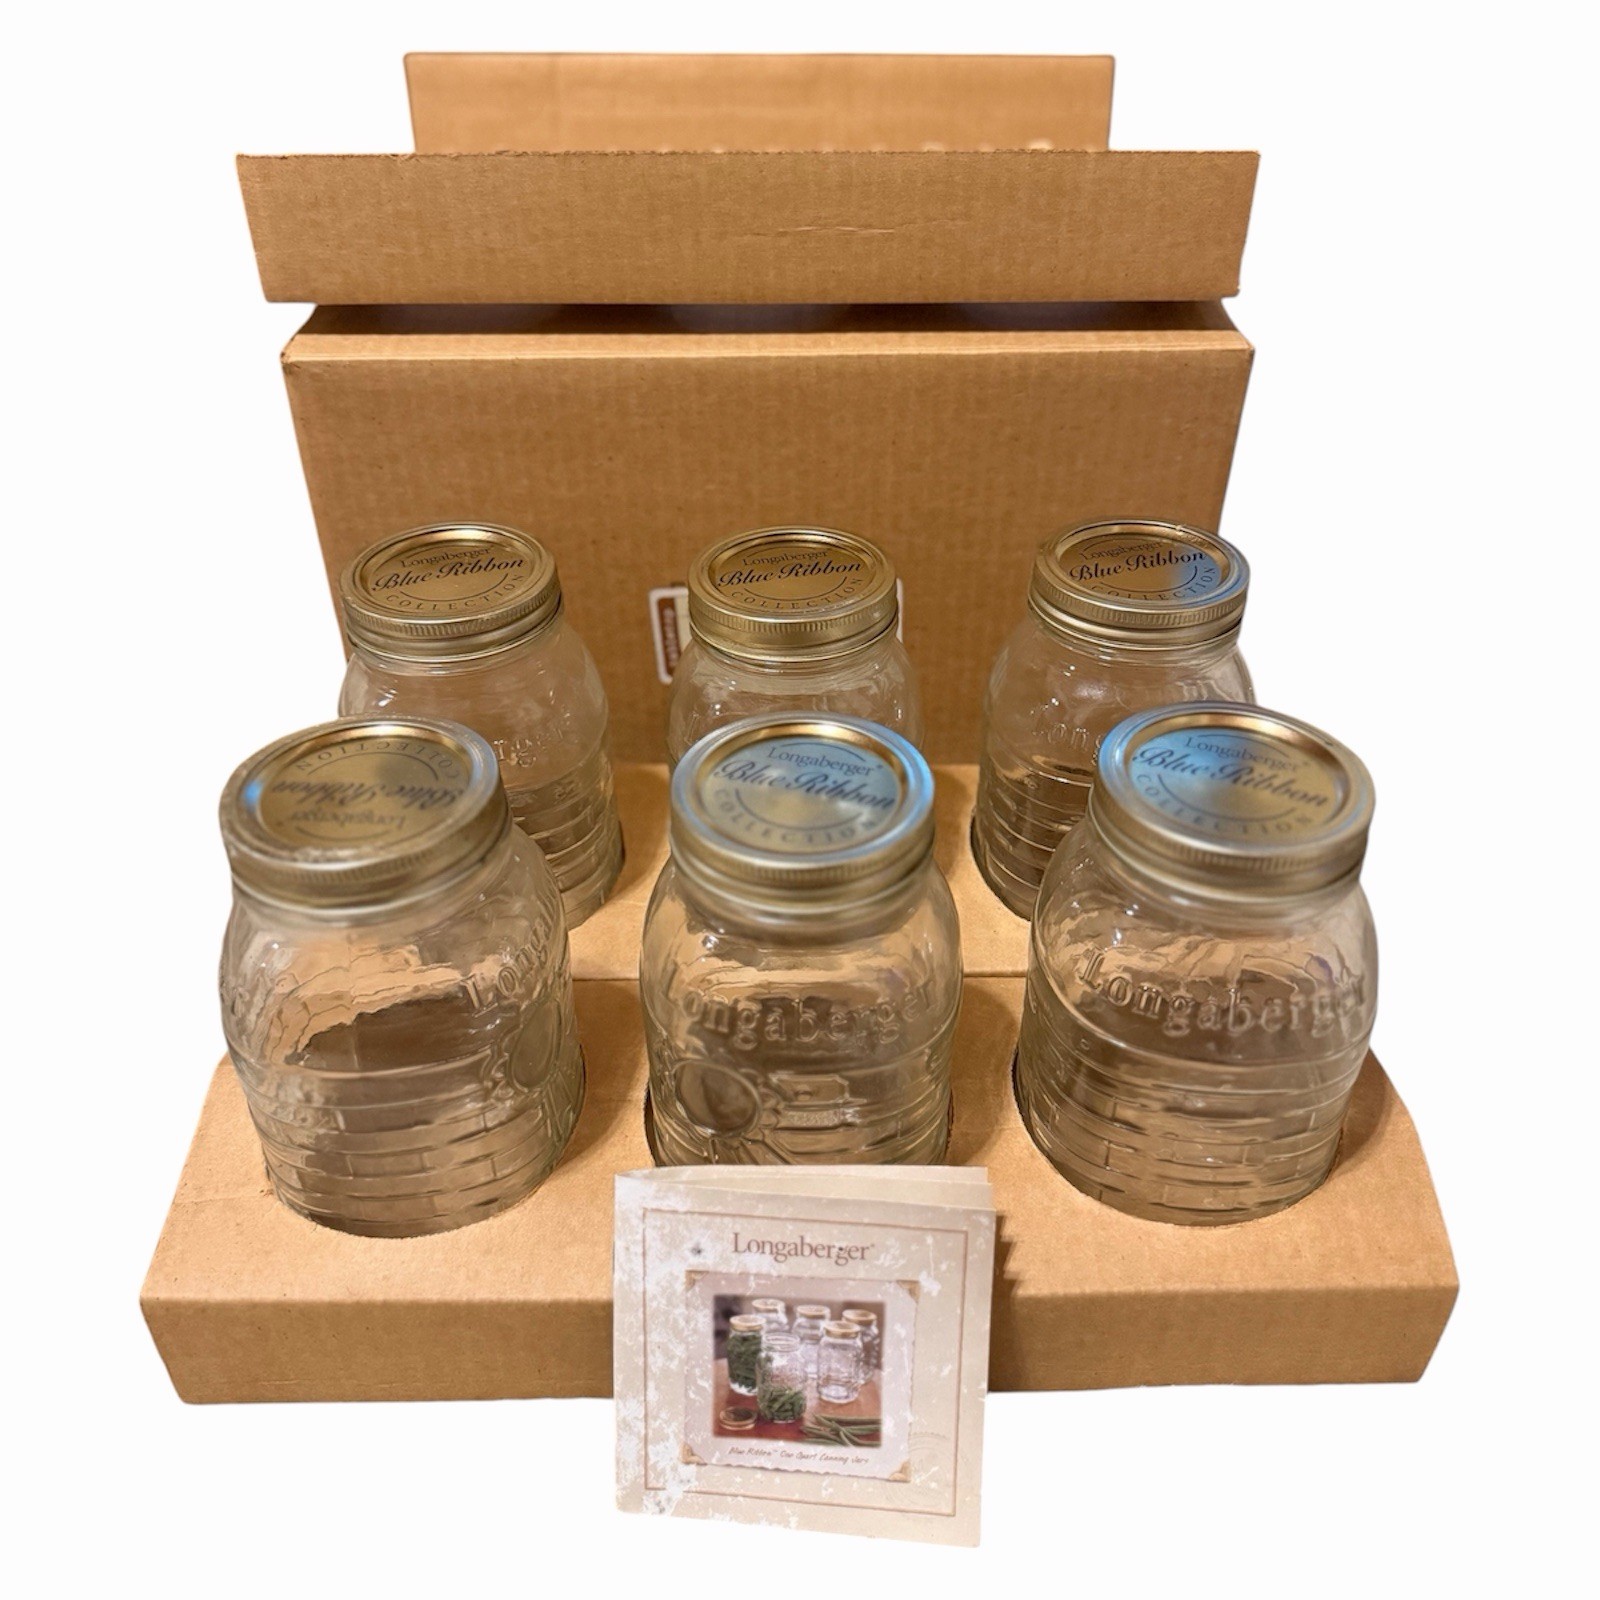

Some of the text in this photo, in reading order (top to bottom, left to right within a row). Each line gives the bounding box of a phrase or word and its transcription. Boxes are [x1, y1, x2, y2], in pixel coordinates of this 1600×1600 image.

[371, 557, 524, 591] Blue Ribbon
[718, 560, 861, 587] Blue Ribbon
[1069, 550, 1205, 581] Blue Ribbon
[386, 574, 524, 610] COLLECTION
[731, 579, 862, 609] COLLECTION
[714, 759, 896, 809] Blue Ribbon
[1132, 747, 1328, 807] Blue Ribbon
[714, 788, 878, 844] COLLECTION
